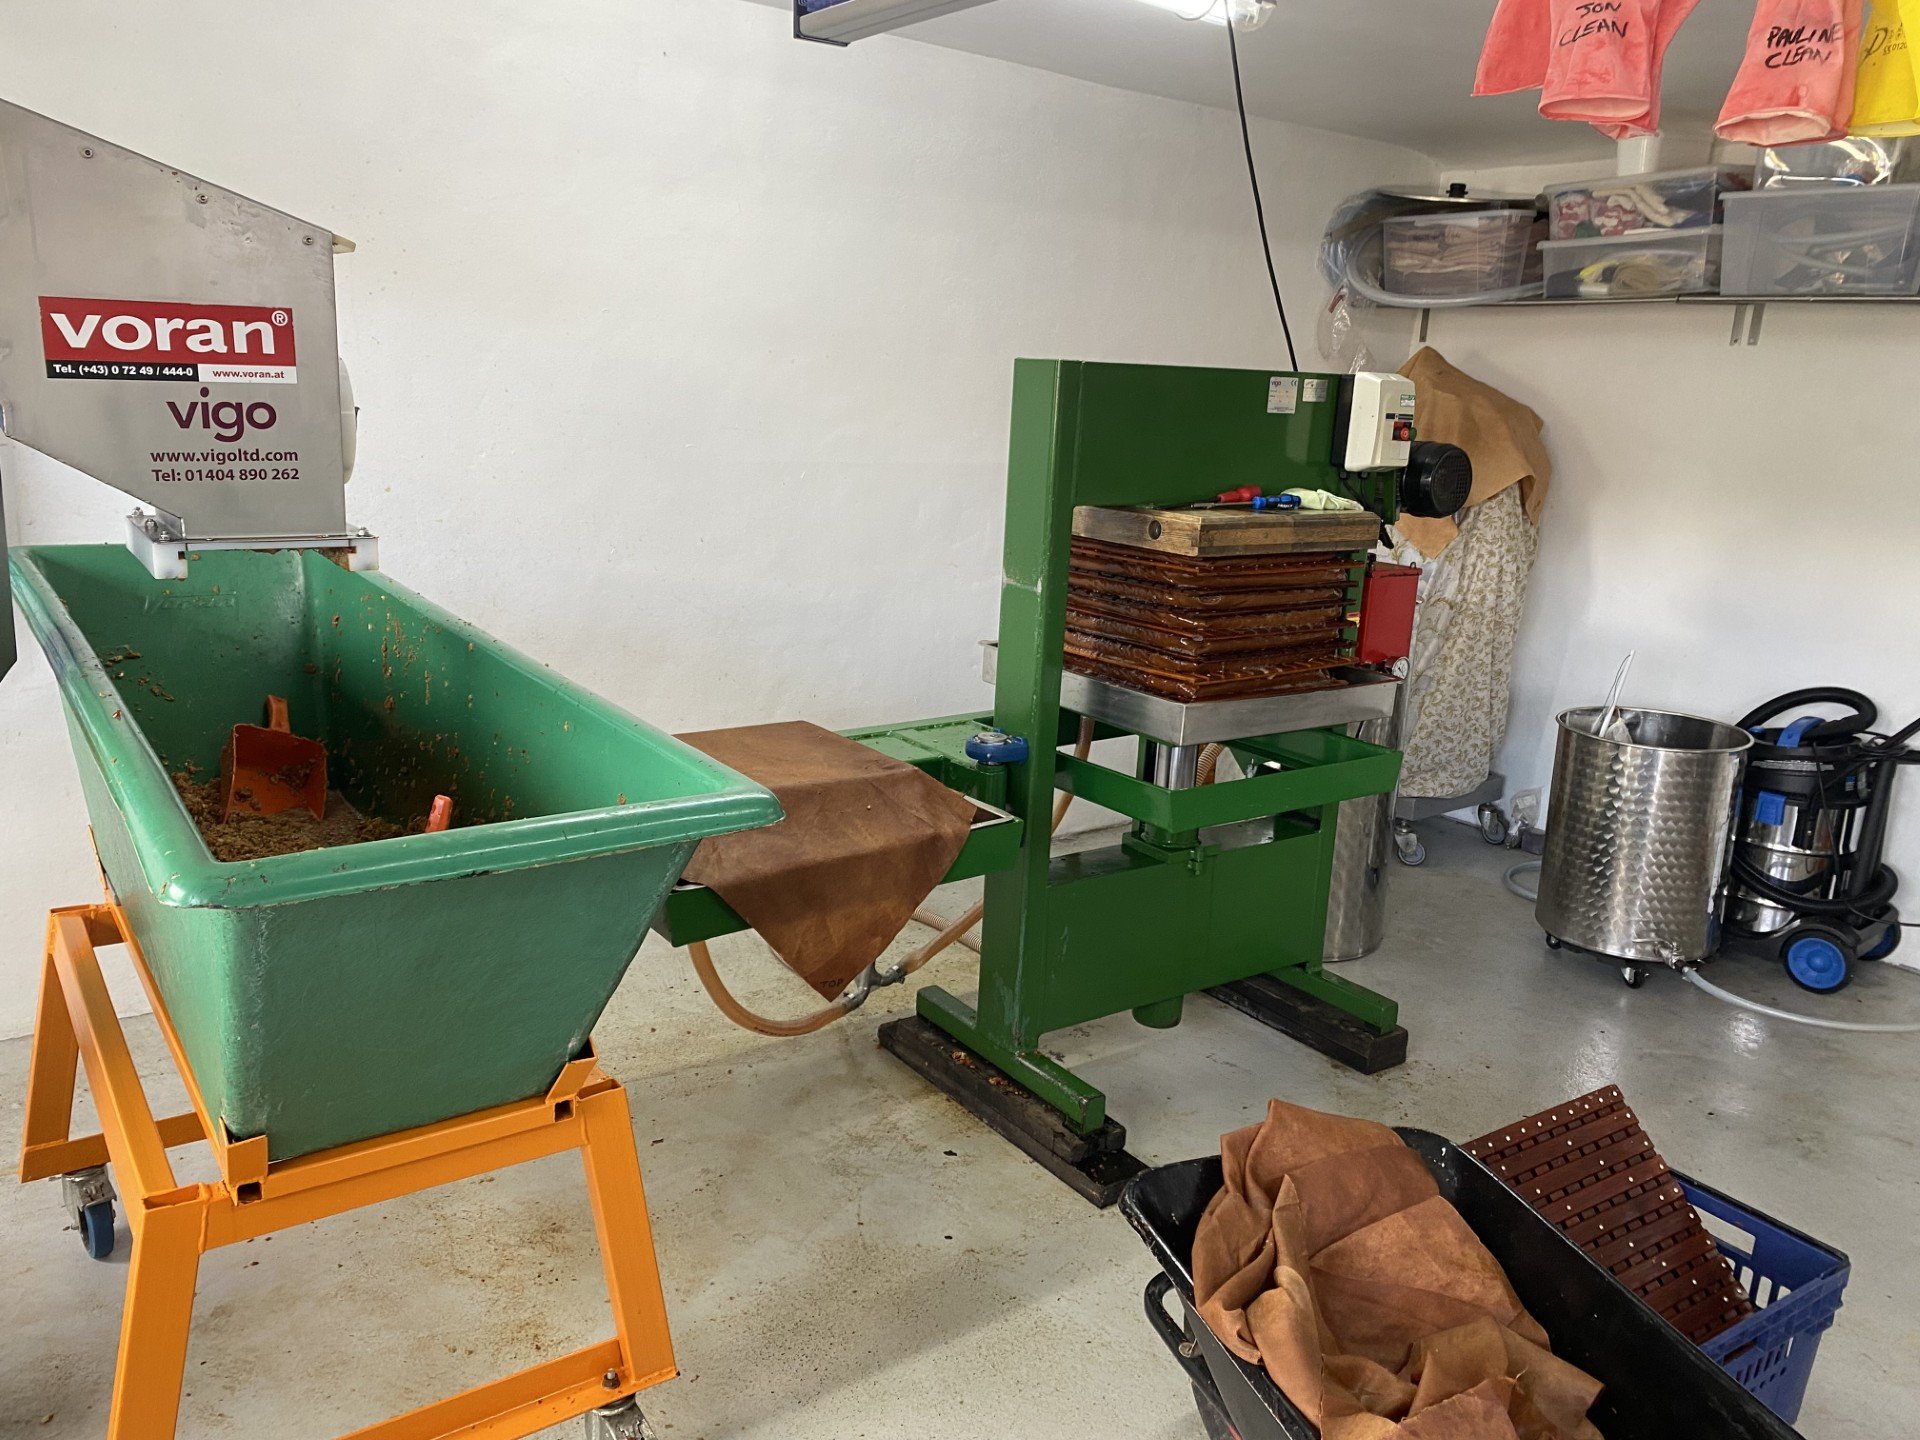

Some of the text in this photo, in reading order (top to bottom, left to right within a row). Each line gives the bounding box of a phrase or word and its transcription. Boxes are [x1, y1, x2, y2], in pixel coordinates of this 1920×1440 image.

[1575, 1, 1622, 19] JON
[1559, 18, 1629, 47] CLEAN
[1766, 22, 1843, 49] PAULINE
[1764, 45, 1832, 69] CLEAN
[53, 364, 76, 374] Tel.
[79, 364, 109, 376] (+43)
[111, 366, 119, 375] 0
[122, 366, 137, 375] 72
[139, 366, 154, 376] 49
[162, 367, 193, 377] 444-0
[212, 370, 285, 379] www.voran.at
[166, 386, 277, 443] vigo
[150, 448, 298, 465] www.vigoltd.com
[152, 468, 300, 482] Tel: 01404 890 262
